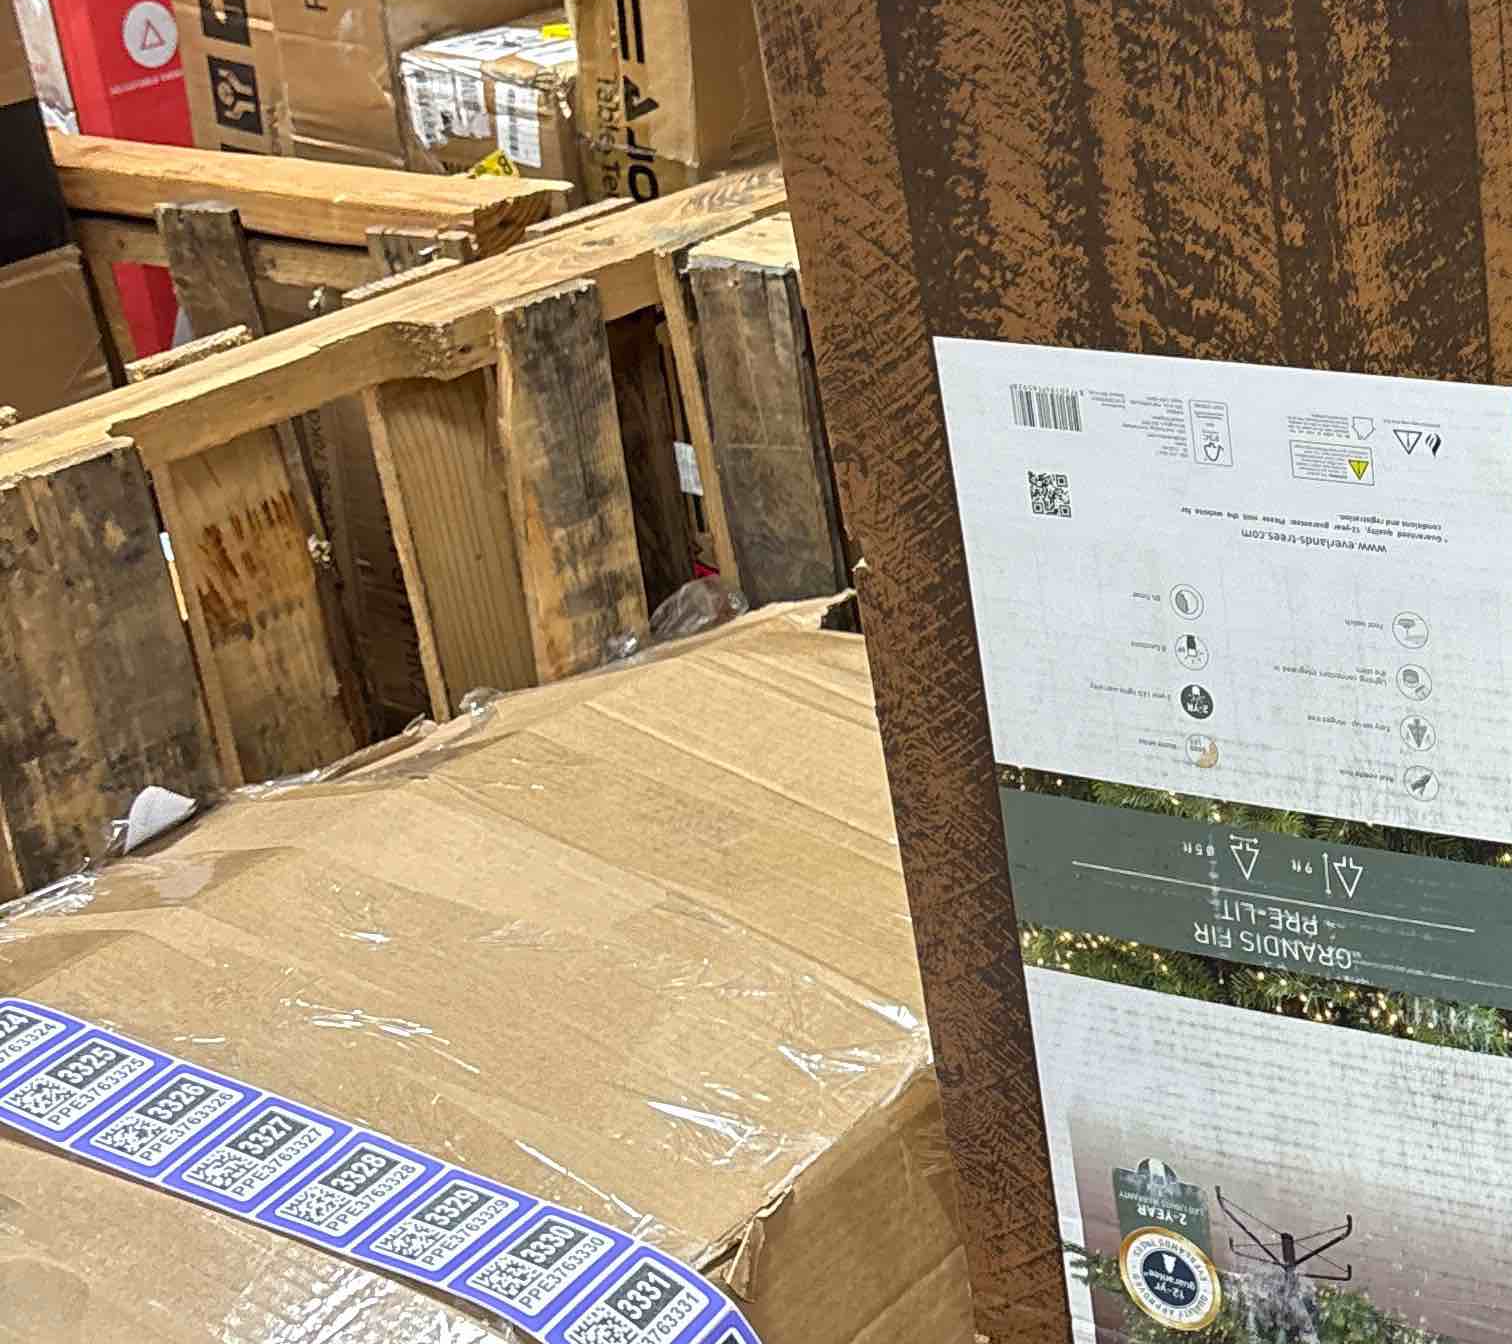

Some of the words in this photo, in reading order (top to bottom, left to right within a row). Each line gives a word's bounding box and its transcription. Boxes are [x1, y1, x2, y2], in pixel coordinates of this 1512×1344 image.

[1240, 527, 1388, 553] www.everlands-trees.com
[1182, 840, 1193, 854] ft
[1291, 858, 1302, 873] ft
[1193, 920, 1233, 949] FIR
[1221, 898, 1319, 936] PRE-LIT
[1239, 929, 1353, 970] GRANDIS
[57, 1045, 117, 1086] 3325
[47, 1058, 145, 1125] PPE3763325
[147, 1082, 206, 1123] 3326
[139, 1092, 234, 1162] PPE3763326
[238, 1114, 294, 1156] 3327
[232, 1126, 324, 1198] PPE3763327
[330, 1153, 387, 1194] 3328
[326, 1163, 418, 1234] PPE3763328
[425, 1189, 480, 1229] 3329
[1136, 1203, 1188, 1227] 2-YEAR
[422, 1198, 511, 1266] PPE3763329
[519, 1223, 575, 1266] 3330
[518, 1236, 606, 1309] PPE3763330
[1154, 1281, 1186, 1300] 12-yr
[616, 1269, 673, 1321] 3331
